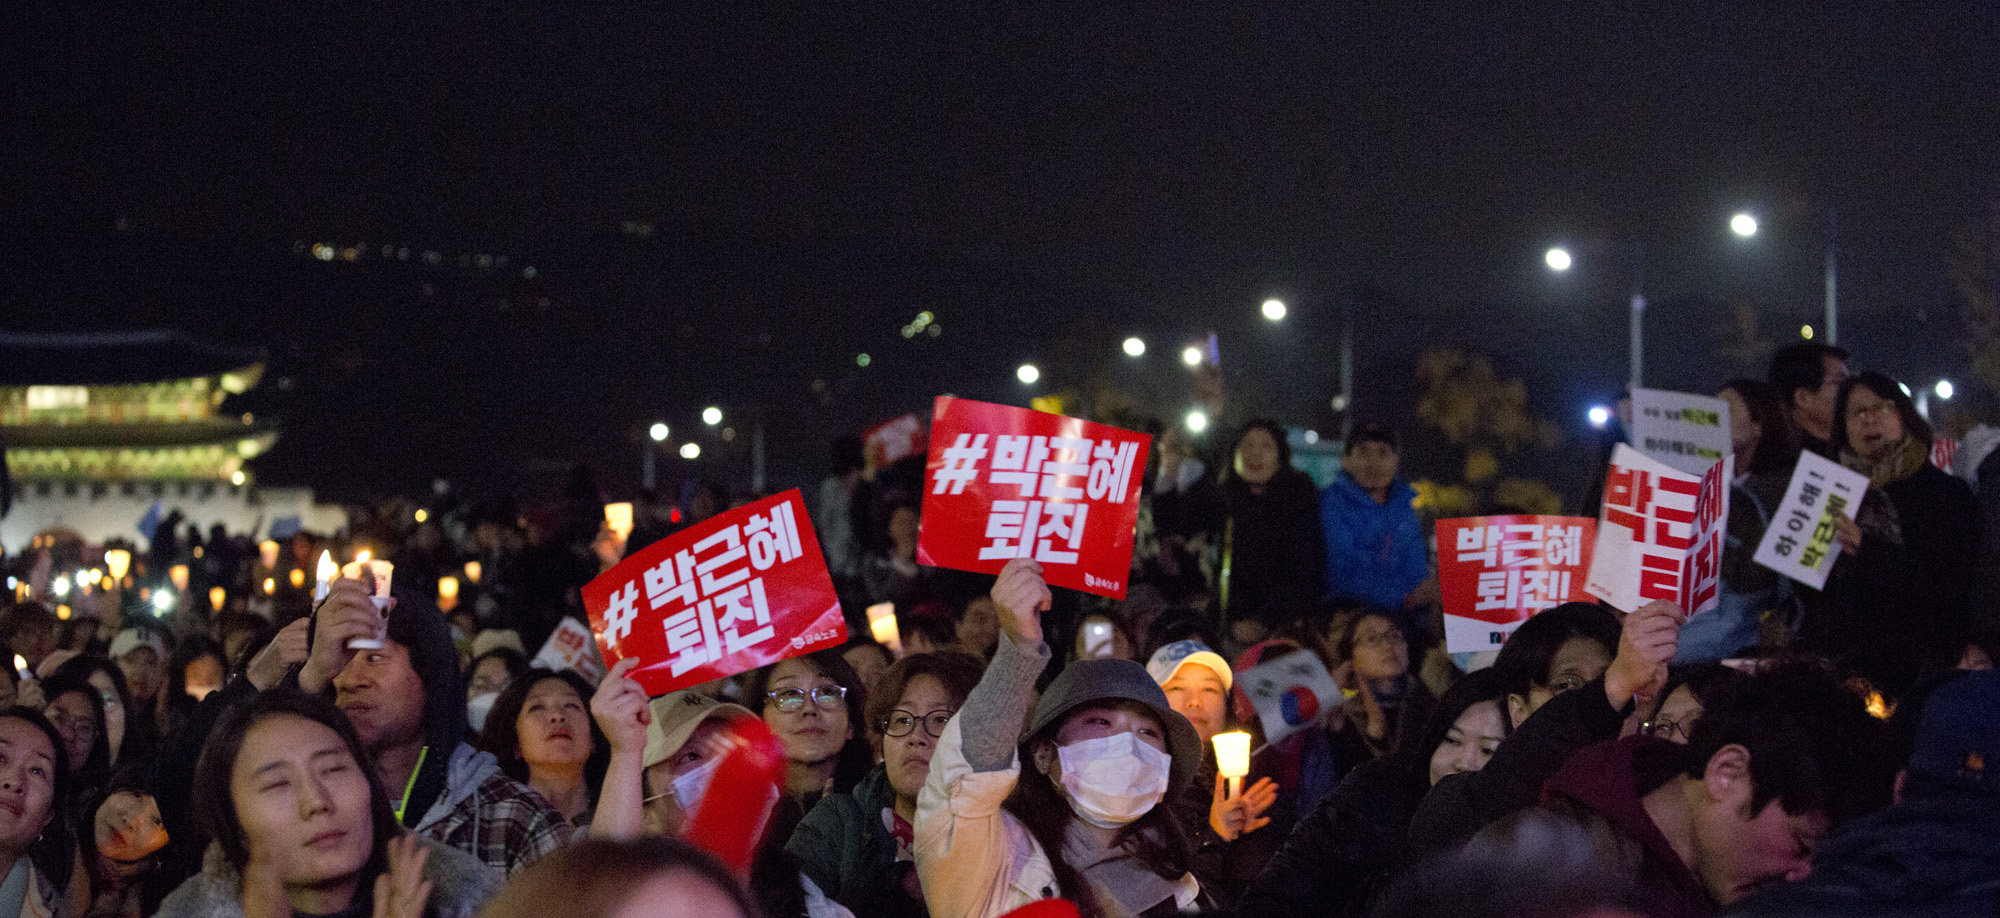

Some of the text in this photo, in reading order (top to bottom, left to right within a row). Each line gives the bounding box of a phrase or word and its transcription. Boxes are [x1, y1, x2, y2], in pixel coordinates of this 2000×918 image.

[932, 433, 1140, 504] #박근혜
[978, 500, 1090, 564] 퇴진
[1605, 459, 1725, 550] 박근혜
[603, 500, 803, 650] #박근혜
[1456, 524, 1583, 568] 박근혜
[1474, 569, 1571, 611] 퇴진!
[662, 577, 775, 678] 퇴진
